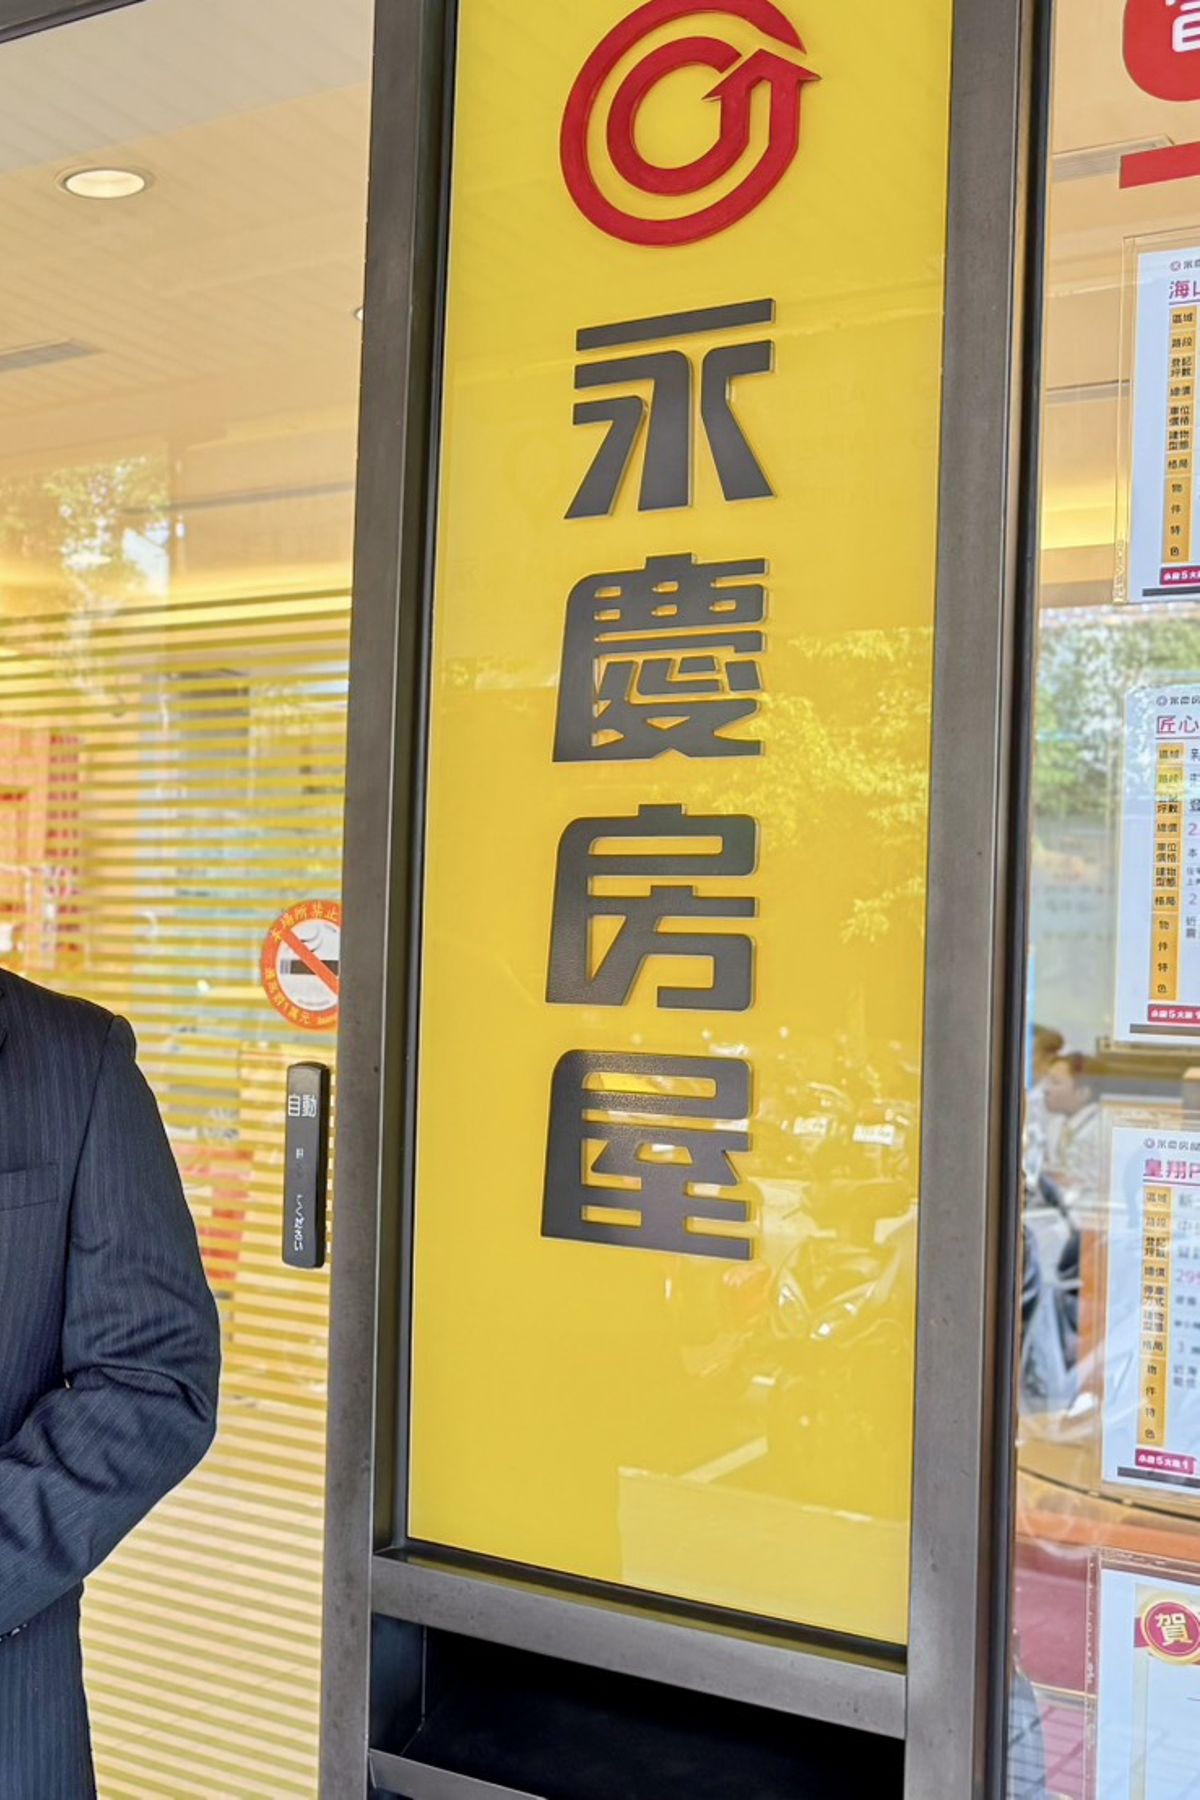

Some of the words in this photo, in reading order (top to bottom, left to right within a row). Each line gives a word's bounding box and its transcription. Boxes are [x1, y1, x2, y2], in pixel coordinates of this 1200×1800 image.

[1156, 715, 1199, 734] 匠心
[541, 298, 775, 1260] 永慶房屋
[1155, 1612, 1193, 1647] 賀
